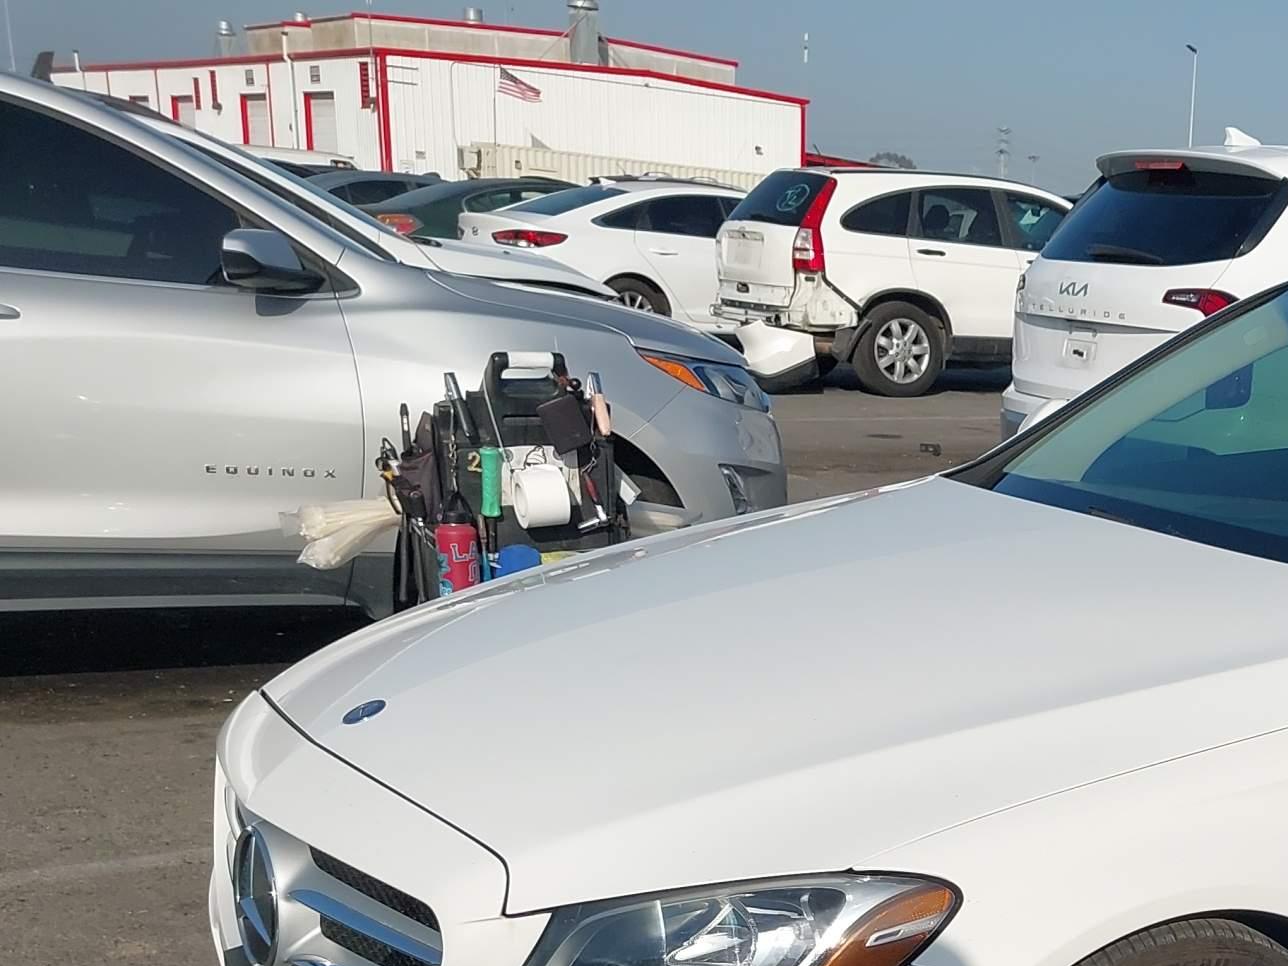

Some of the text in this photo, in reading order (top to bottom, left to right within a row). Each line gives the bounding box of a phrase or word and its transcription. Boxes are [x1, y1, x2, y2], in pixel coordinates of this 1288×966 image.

[1059, 282, 1089, 297] KIA
[1032, 303, 1126, 320] TELLURIDE
[204, 464, 336, 479] EQUINOX
